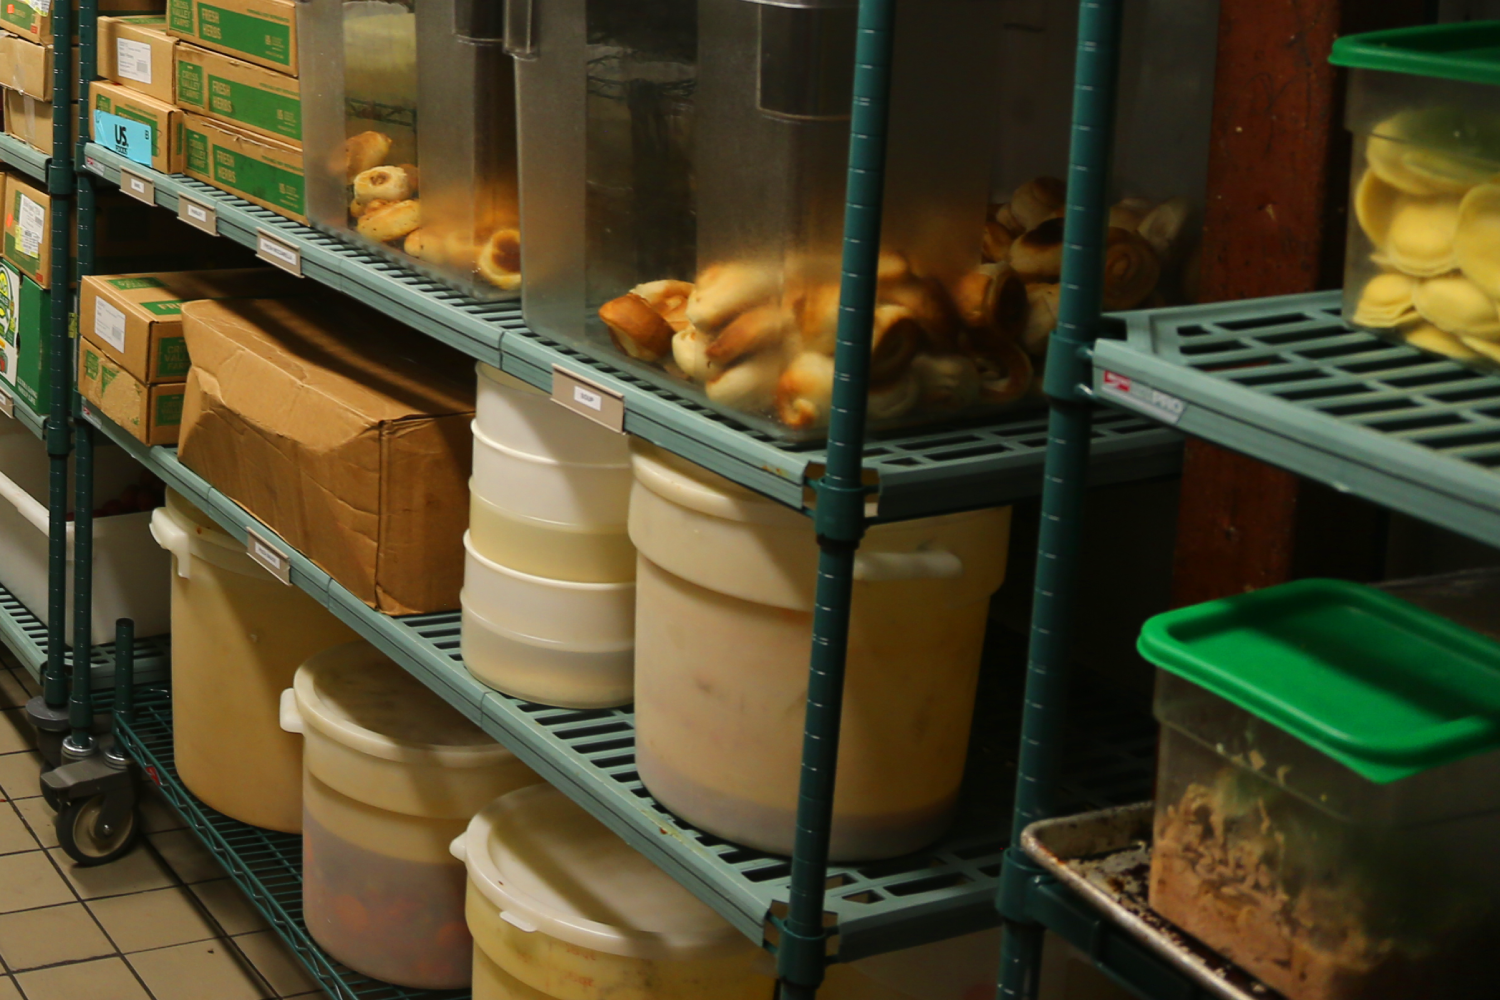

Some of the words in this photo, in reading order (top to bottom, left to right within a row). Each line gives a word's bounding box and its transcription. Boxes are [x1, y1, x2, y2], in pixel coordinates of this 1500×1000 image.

[172, 7, 190, 19] VALLEY
[202, 8, 220, 24] FRESH
[174, 17, 189, 28] FARMS
[203, 23, 222, 39] HERBS
[182, 69, 199, 81] CROSS
[181, 78, 200, 91] VALLEY
[212, 80, 231, 97] FRESH
[183, 88, 199, 100] FARMS
[213, 95, 232, 113] HERBS
[217, 150, 234, 167] FRESH
[218, 166, 236, 183] HERBS
[1152, 393, 1185, 416] PRO
